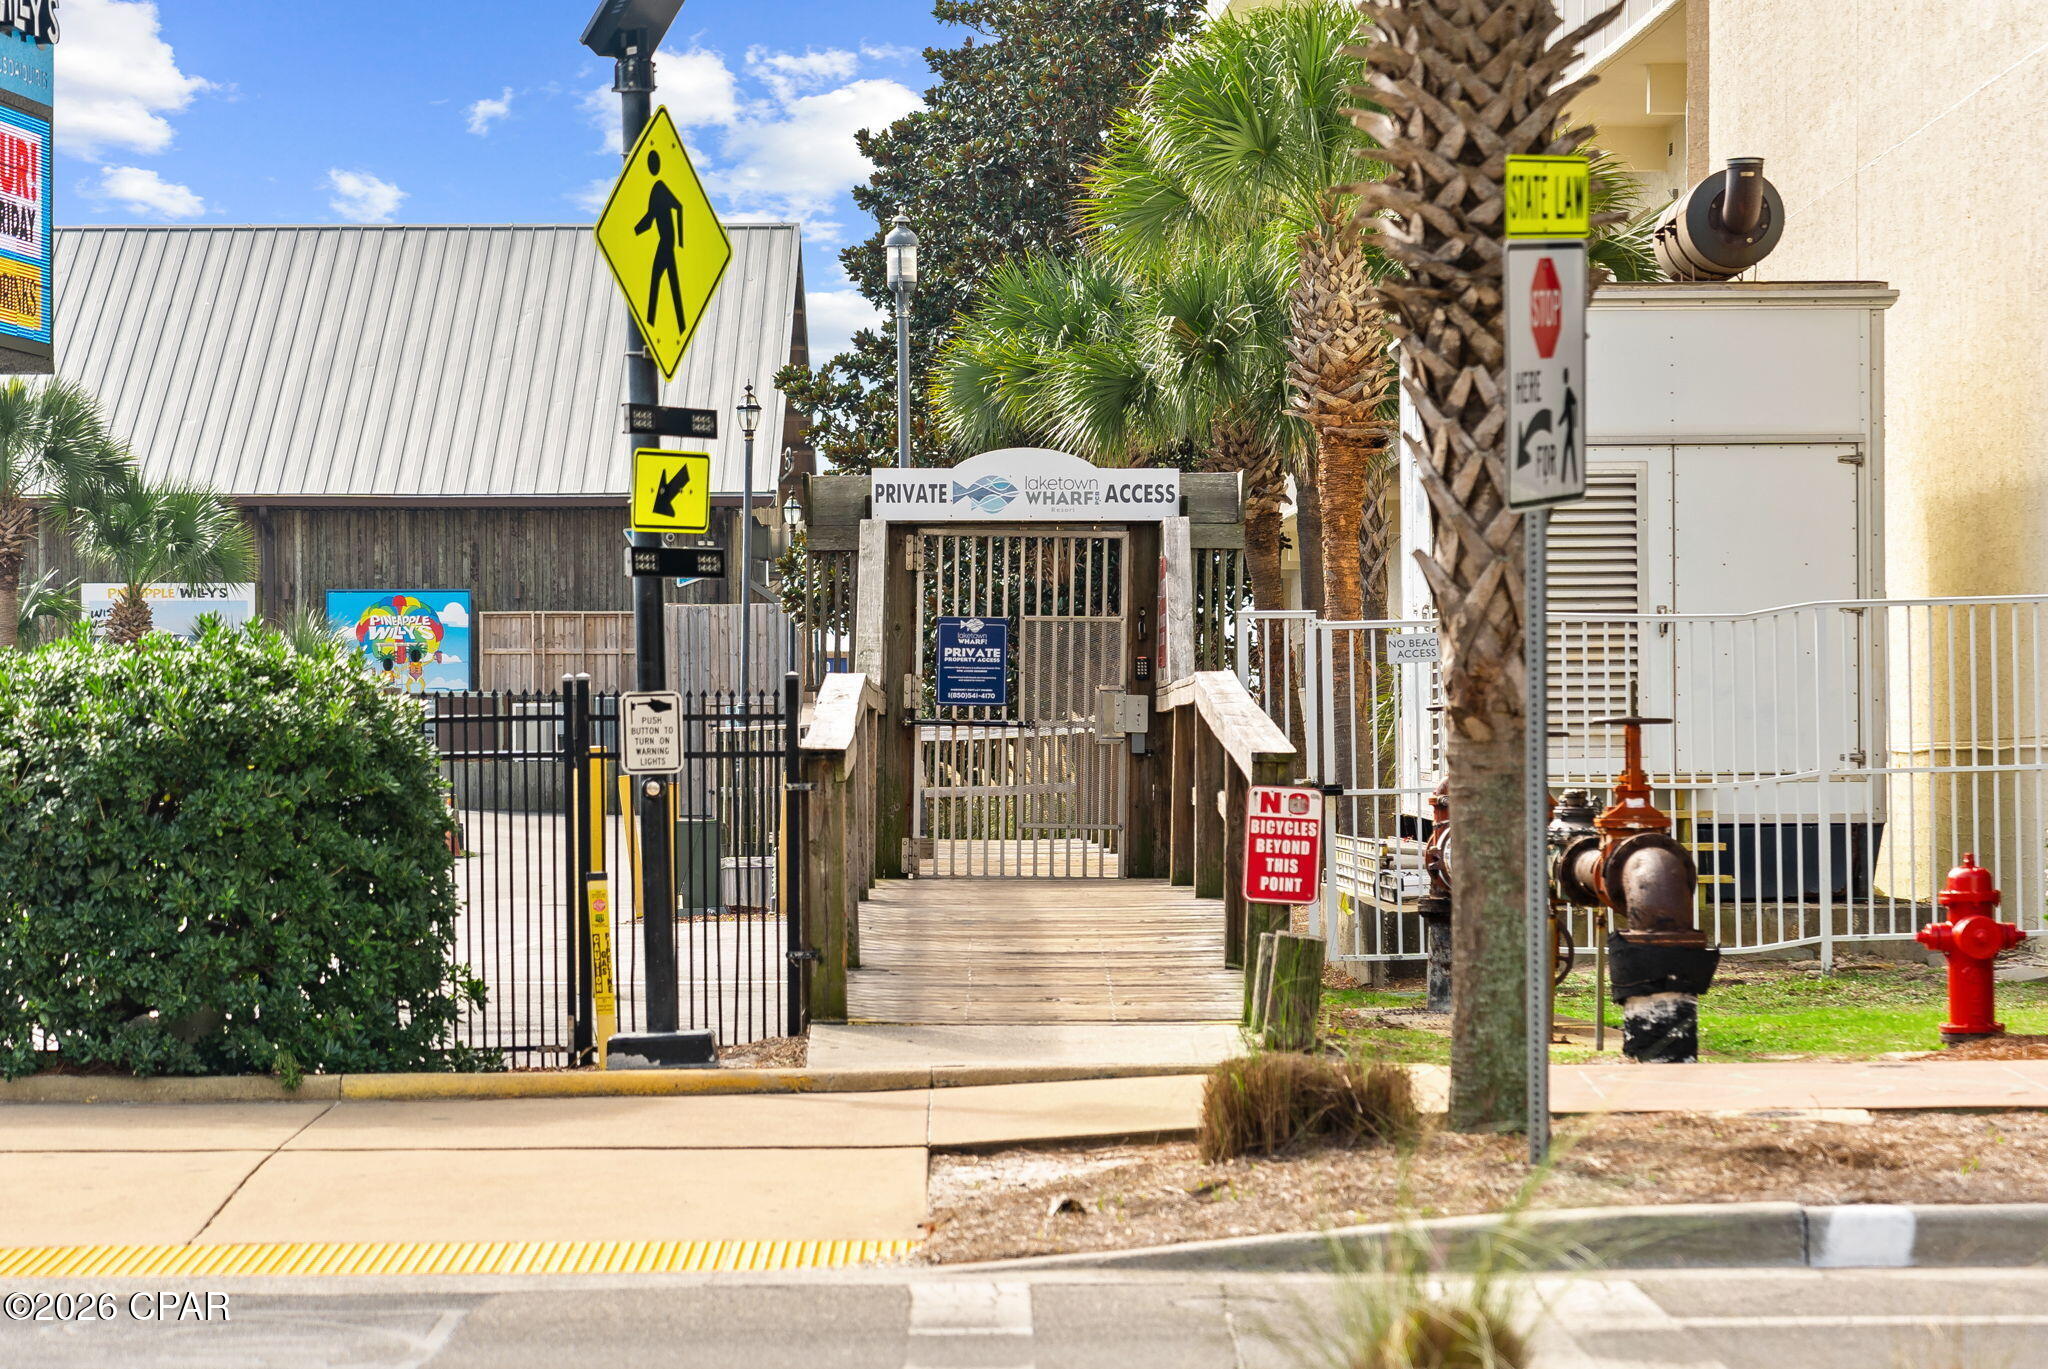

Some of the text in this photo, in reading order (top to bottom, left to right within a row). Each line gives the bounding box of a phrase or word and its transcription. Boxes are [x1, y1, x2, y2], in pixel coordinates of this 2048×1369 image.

[1509, 175, 1586, 219] STATE LAW
[1532, 289, 1560, 328] STOP
[1516, 370, 1542, 404] HERE
[1536, 443, 1557, 478] FOR
[1025, 475, 1099, 490] laketown
[875, 483, 947, 503] PRIVATE
[1025, 491, 1094, 505] WHARF
[1104, 483, 1176, 503] ACCESS
[369, 615, 431, 626] PINEAPPLE
[368, 625, 435, 640] WILLY'S
[1388, 639, 1406, 648] NO
[944, 647, 1001, 658] PRIVATE
[1397, 649, 1437, 658] ACCESS
[641, 716, 662, 724] PUSH
[631, 726, 674, 735] BUTTON TO
[635, 737, 670, 745] TURN ON
[636, 747, 670, 755] WARNING
[640, 758, 666, 766] LIGHTS
[1260, 791, 1310, 815] NO
[1250, 818, 1317, 837] BICYCLES
[1256, 838, 1311, 855] BEYOND
[1265, 857, 1299, 873] THIS
[1259, 876, 1303, 892] POINT
[593, 933, 603, 993] CAUTION
[605, 932, 613, 993] PIPELINE
